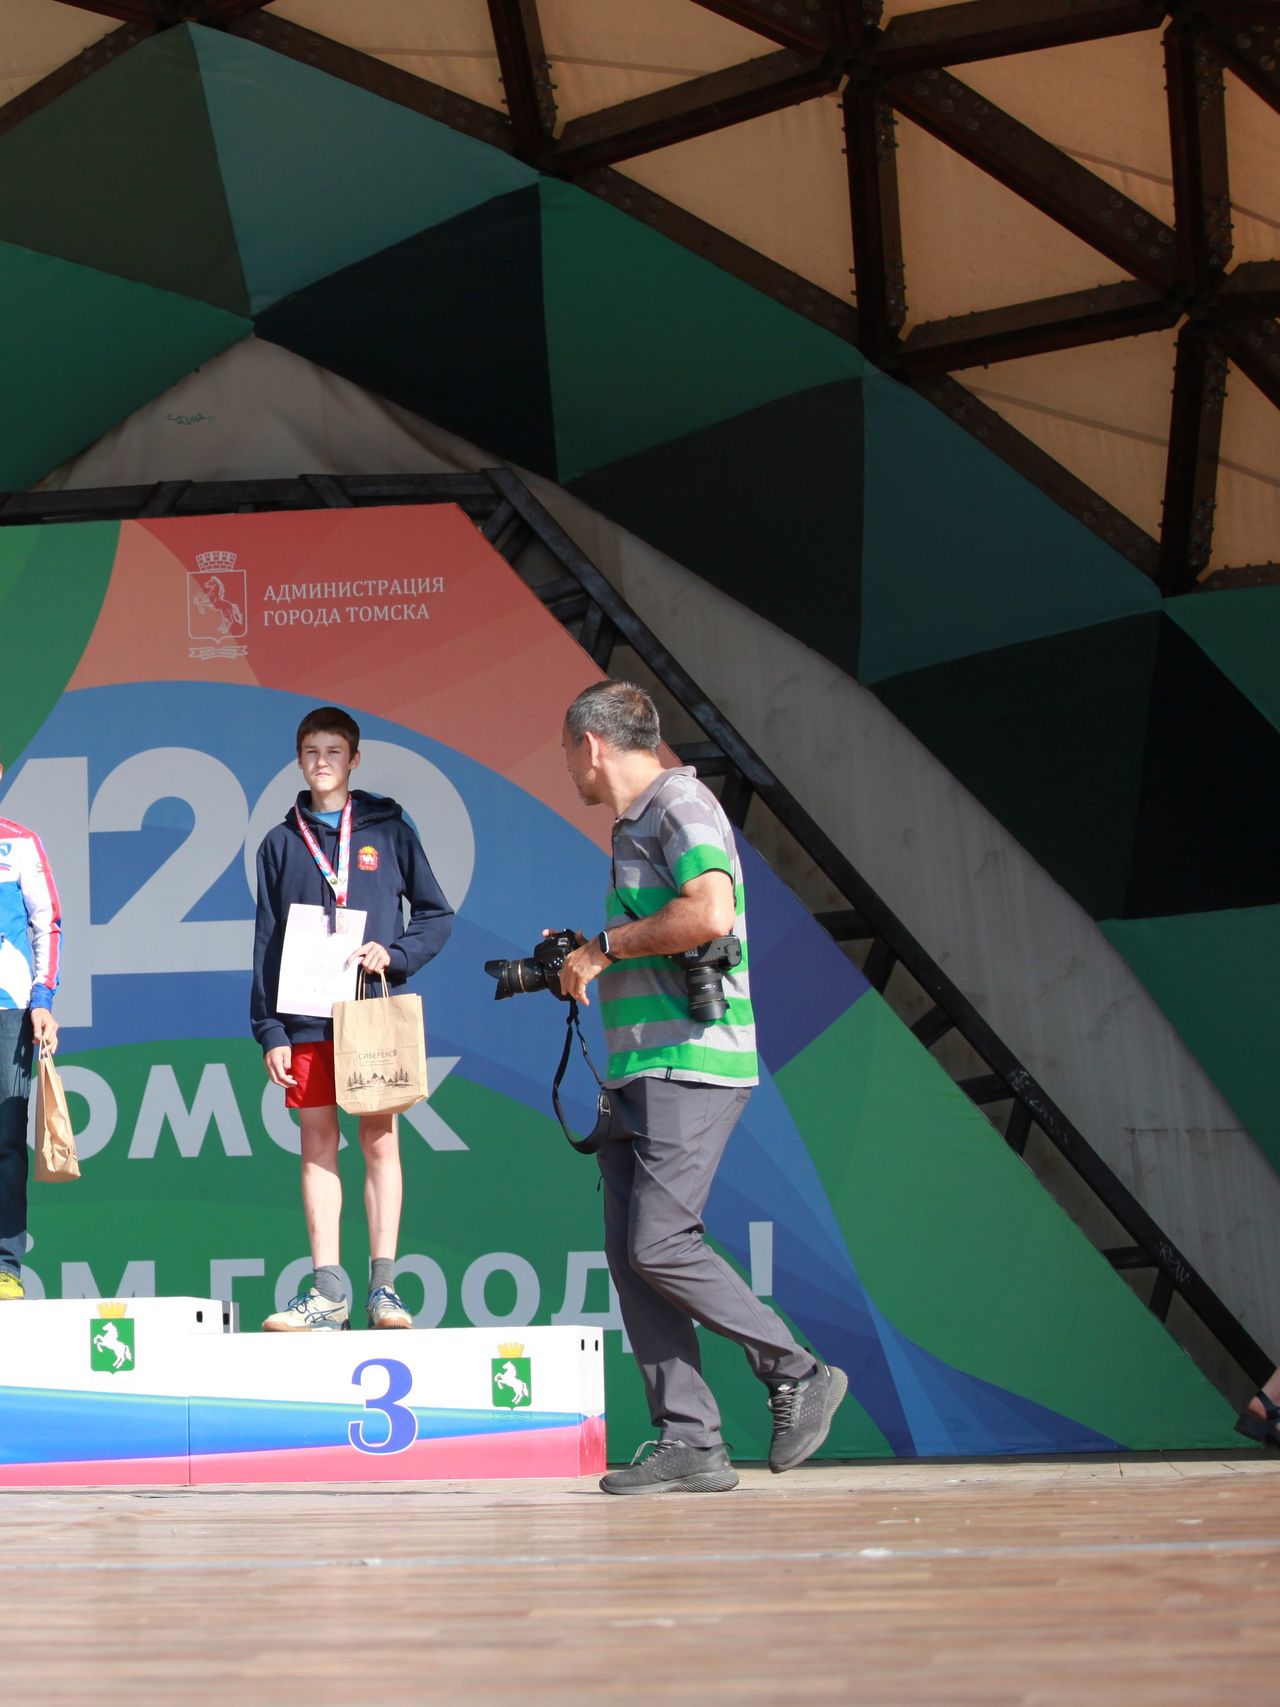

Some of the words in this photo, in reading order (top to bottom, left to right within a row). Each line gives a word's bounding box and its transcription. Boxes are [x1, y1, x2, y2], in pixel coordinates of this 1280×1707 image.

[263, 577, 445, 603] АДМИНИСТРАЦИЯ
[263, 608, 342, 627] ГОРОДА
[346, 603, 431, 623] ТОМСКА
[347, 1357, 419, 1455] 3
